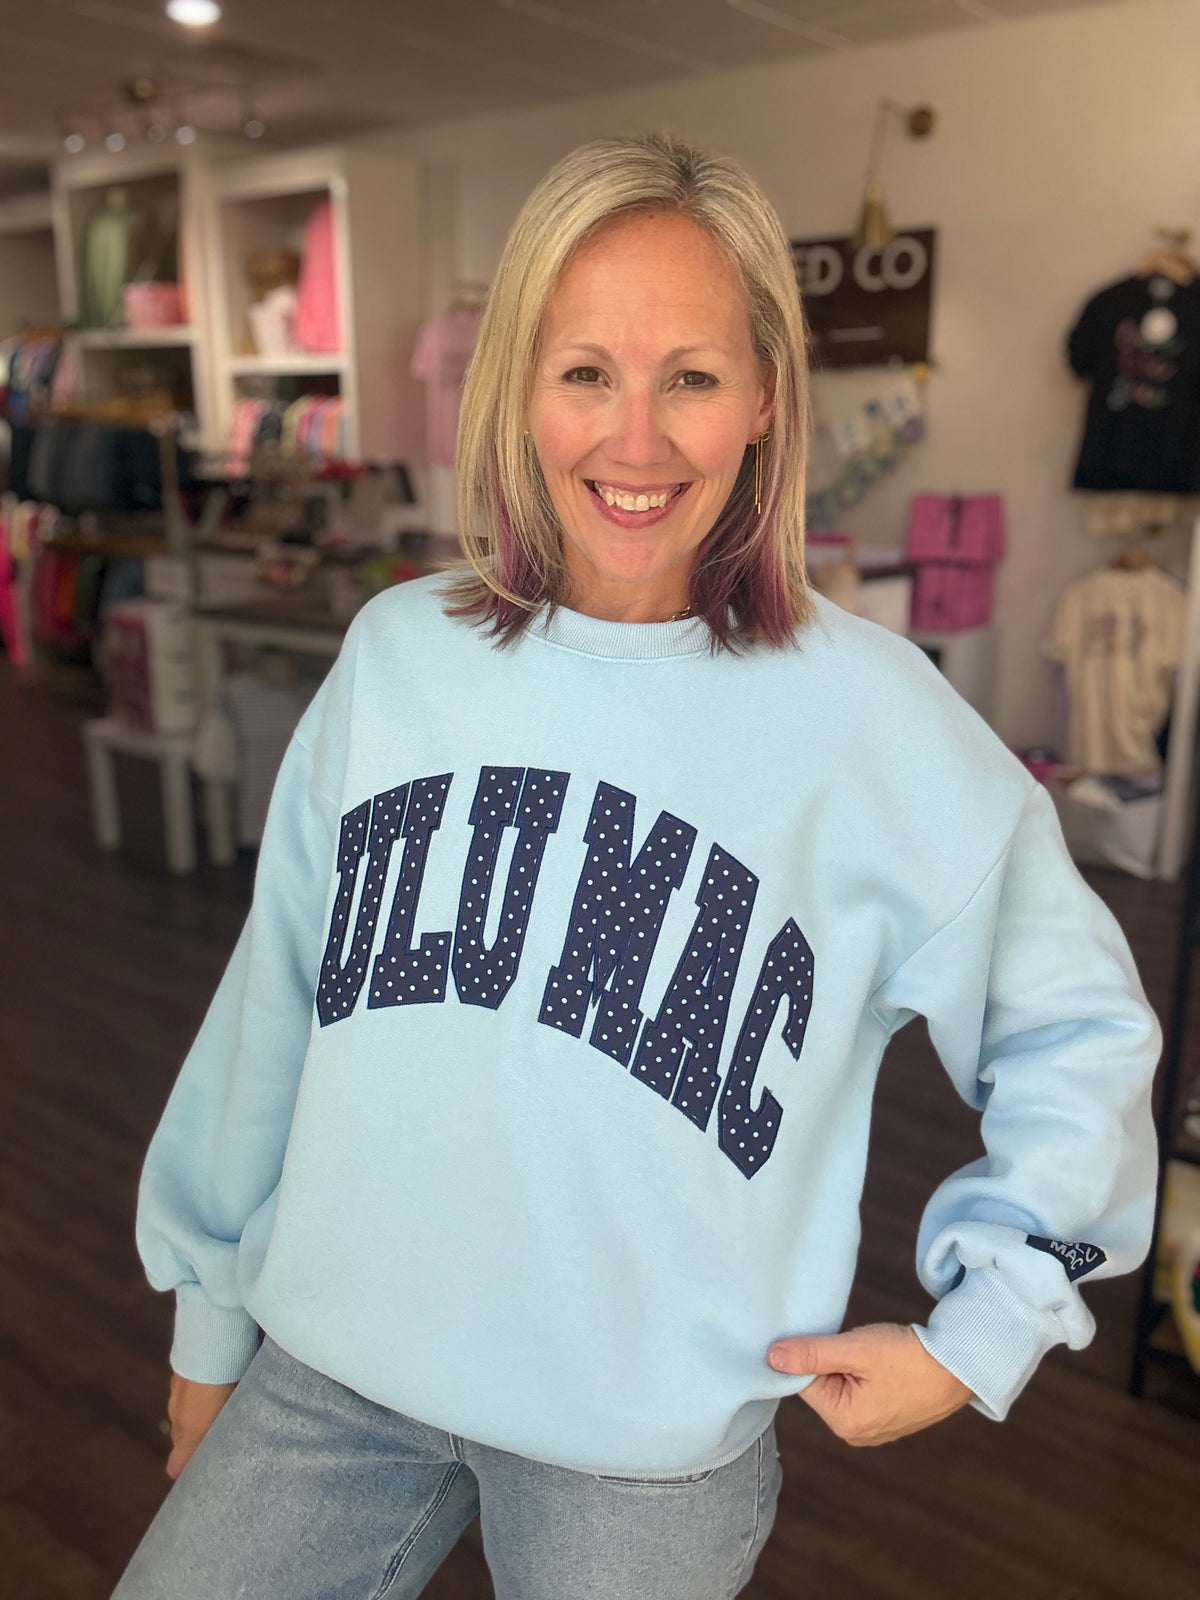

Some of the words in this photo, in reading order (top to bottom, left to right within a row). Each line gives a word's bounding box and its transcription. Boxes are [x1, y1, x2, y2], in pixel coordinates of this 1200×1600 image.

[853, 235, 928, 293] CO
[316, 765, 571, 1028] ULU
[537, 780, 815, 1180] MAC
[1049, 1240, 1084, 1270] MAC
